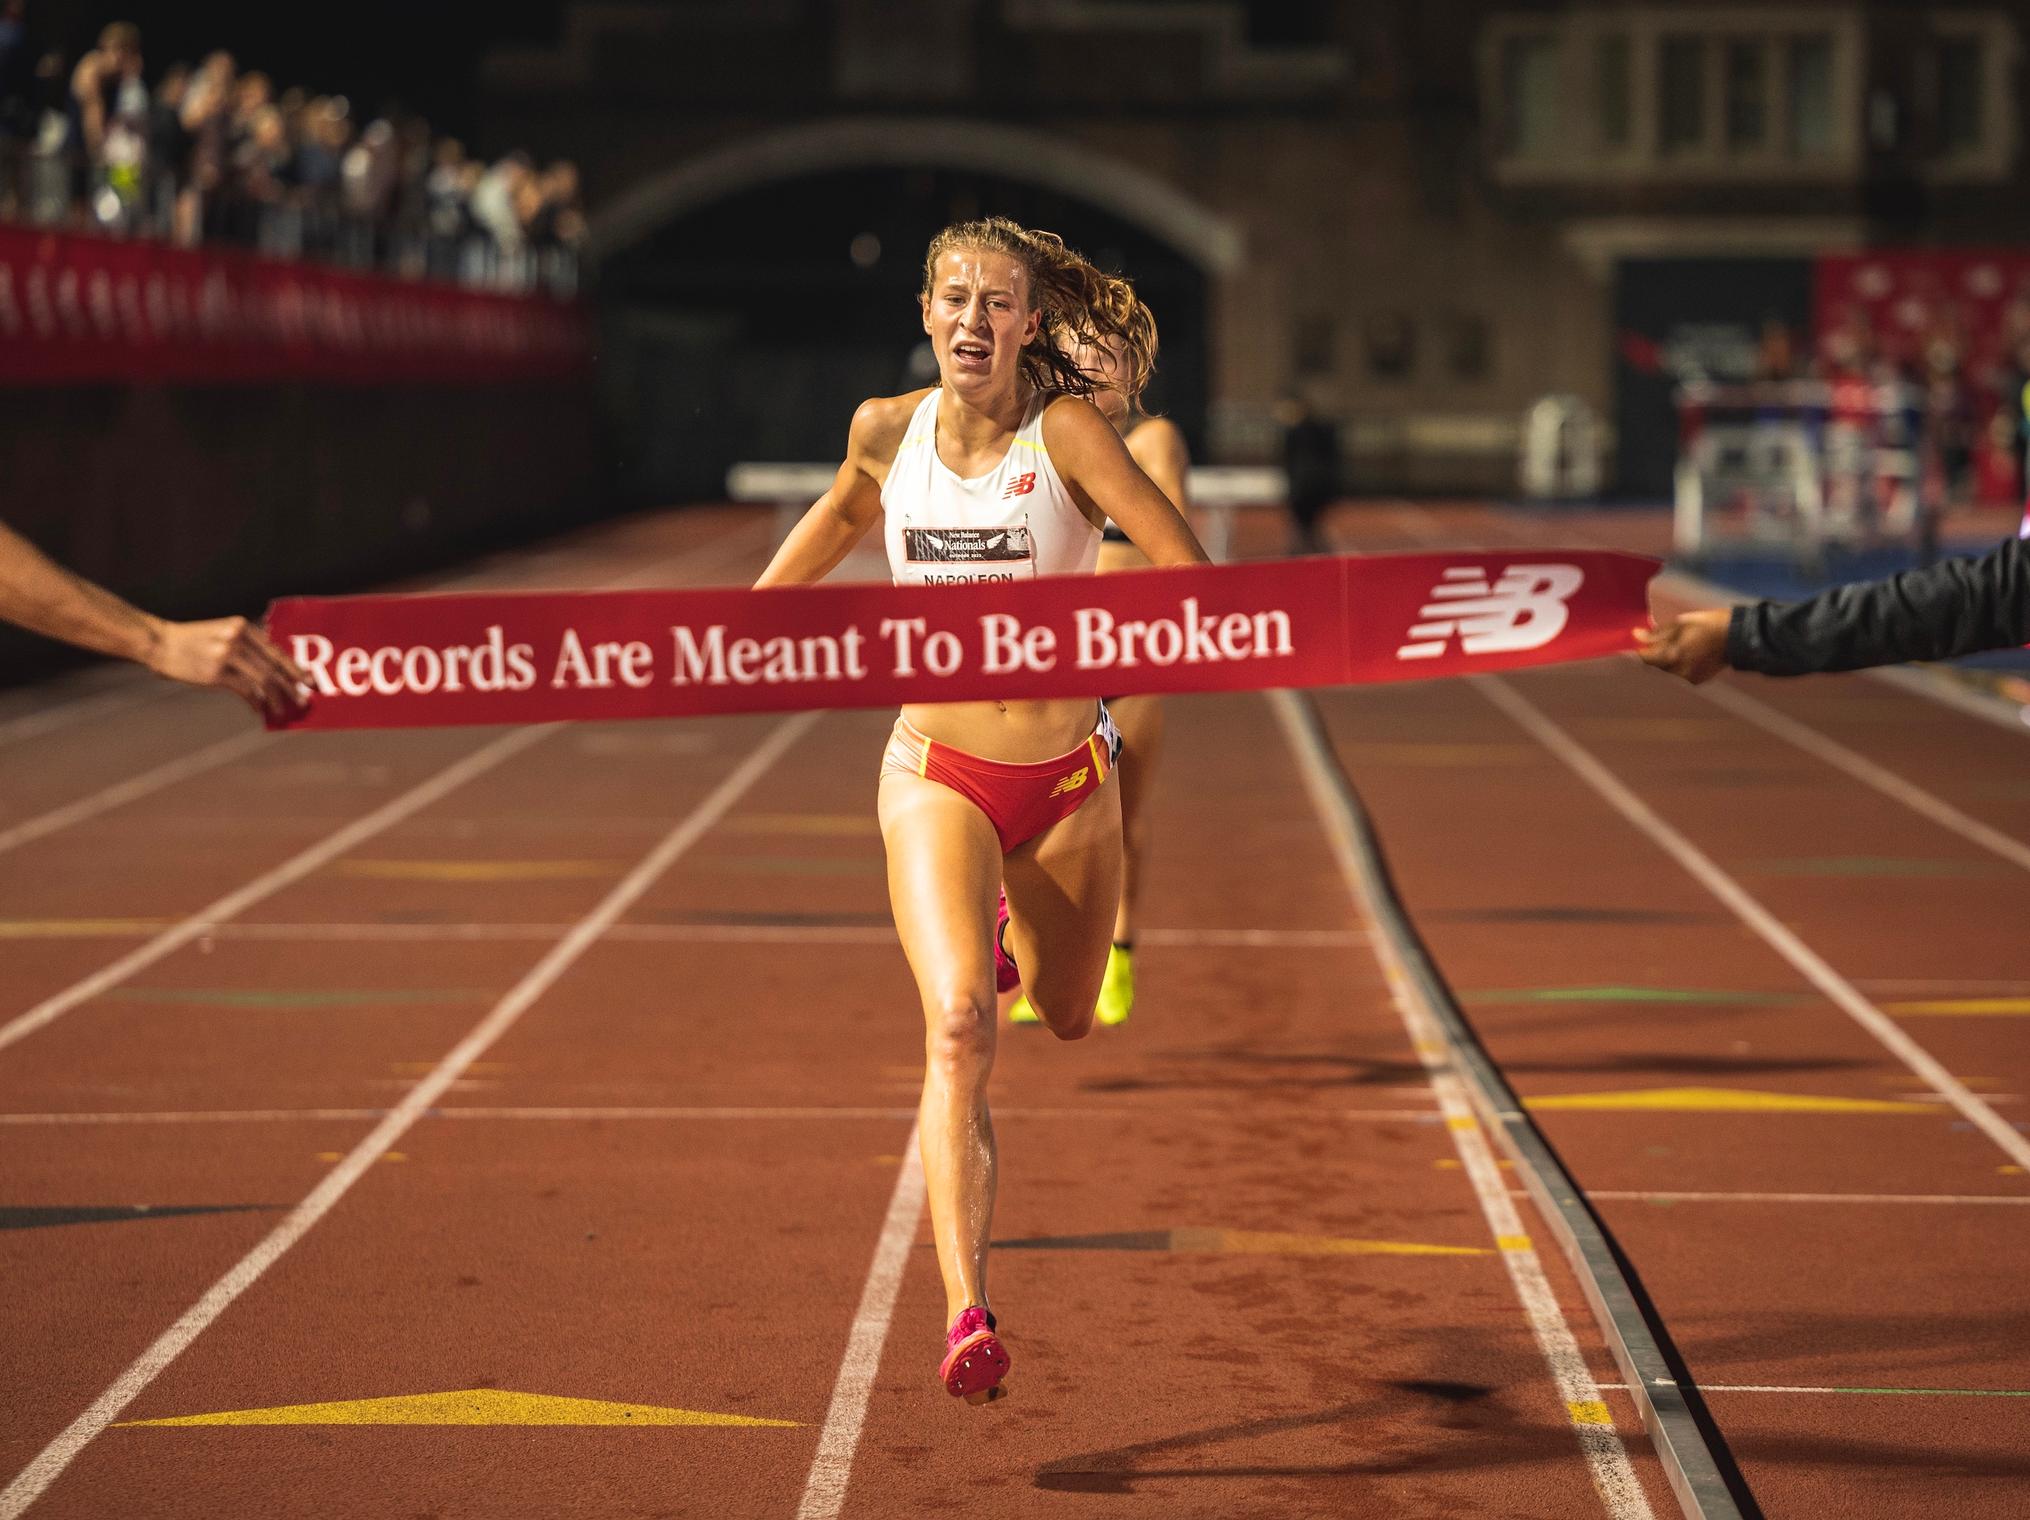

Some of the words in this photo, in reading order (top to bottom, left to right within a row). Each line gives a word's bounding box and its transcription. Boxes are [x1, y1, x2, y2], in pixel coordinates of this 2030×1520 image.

[944, 539, 986, 550] Nationals
[290, 624, 537, 697] Records
[551, 627, 654, 690] Are
[669, 623, 868, 686] Meant
[879, 616, 964, 679] To
[979, 612, 1057, 675] Be
[1072, 597, 1295, 671] Broken
